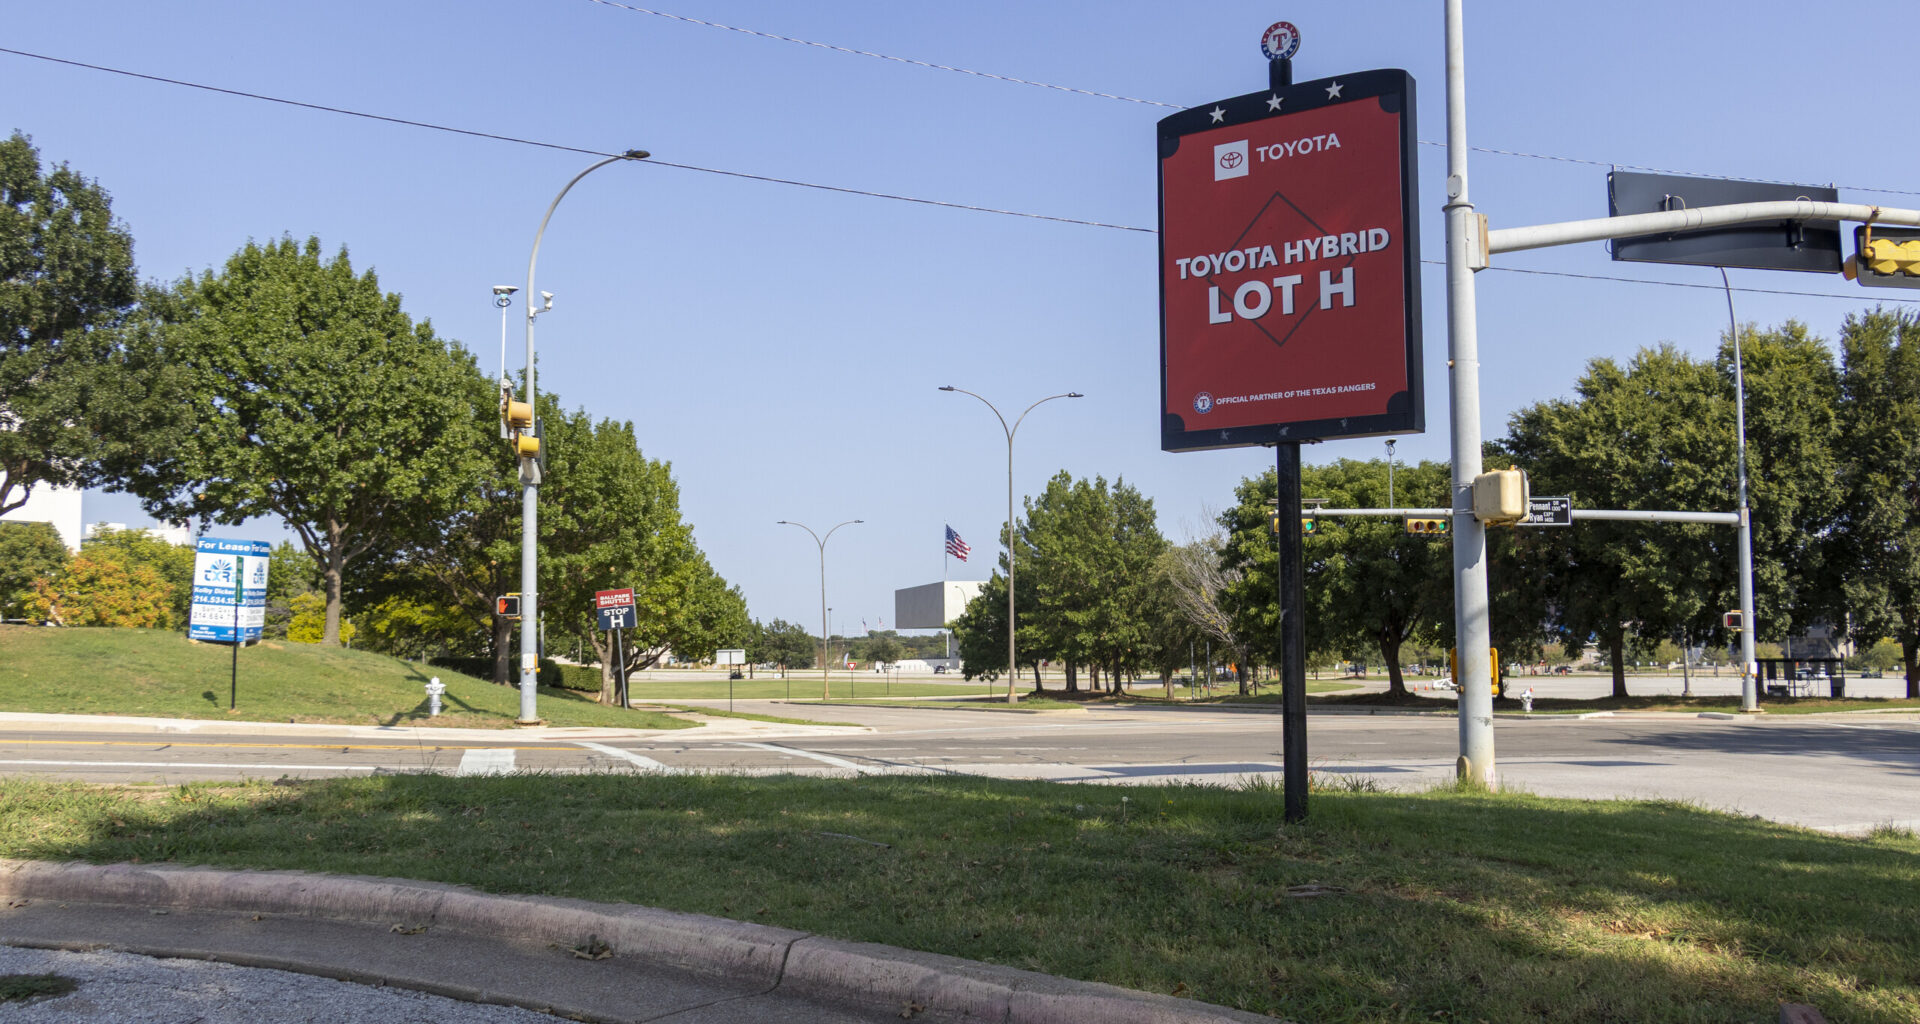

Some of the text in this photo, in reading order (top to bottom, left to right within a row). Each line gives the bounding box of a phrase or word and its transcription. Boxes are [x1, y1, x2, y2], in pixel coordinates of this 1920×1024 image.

[1272, 32, 1288, 50] T
[1256, 133, 1341, 162] TOYOTA
[1176, 228, 1389, 280] TOYOTA HYBRID
[1208, 267, 1355, 324] LOT H
[1216, 395, 1248, 405] OFFICIAL
[1249, 392, 1283, 402] PARTNER
[1284, 390, 1295, 399] OF
[1296, 388, 1311, 398] THE
[1312, 386, 1336, 396] TEXAS
[1338, 382, 1376, 394] RANGERS
[1529, 501, 1550, 511] Pennant
[1530, 512, 1543, 523] Ryan
[198, 541, 250, 552] For Lease
[600, 593, 630, 601] BALLPARK
[603, 607, 629, 616] STOP
[610, 614, 624, 628] H
